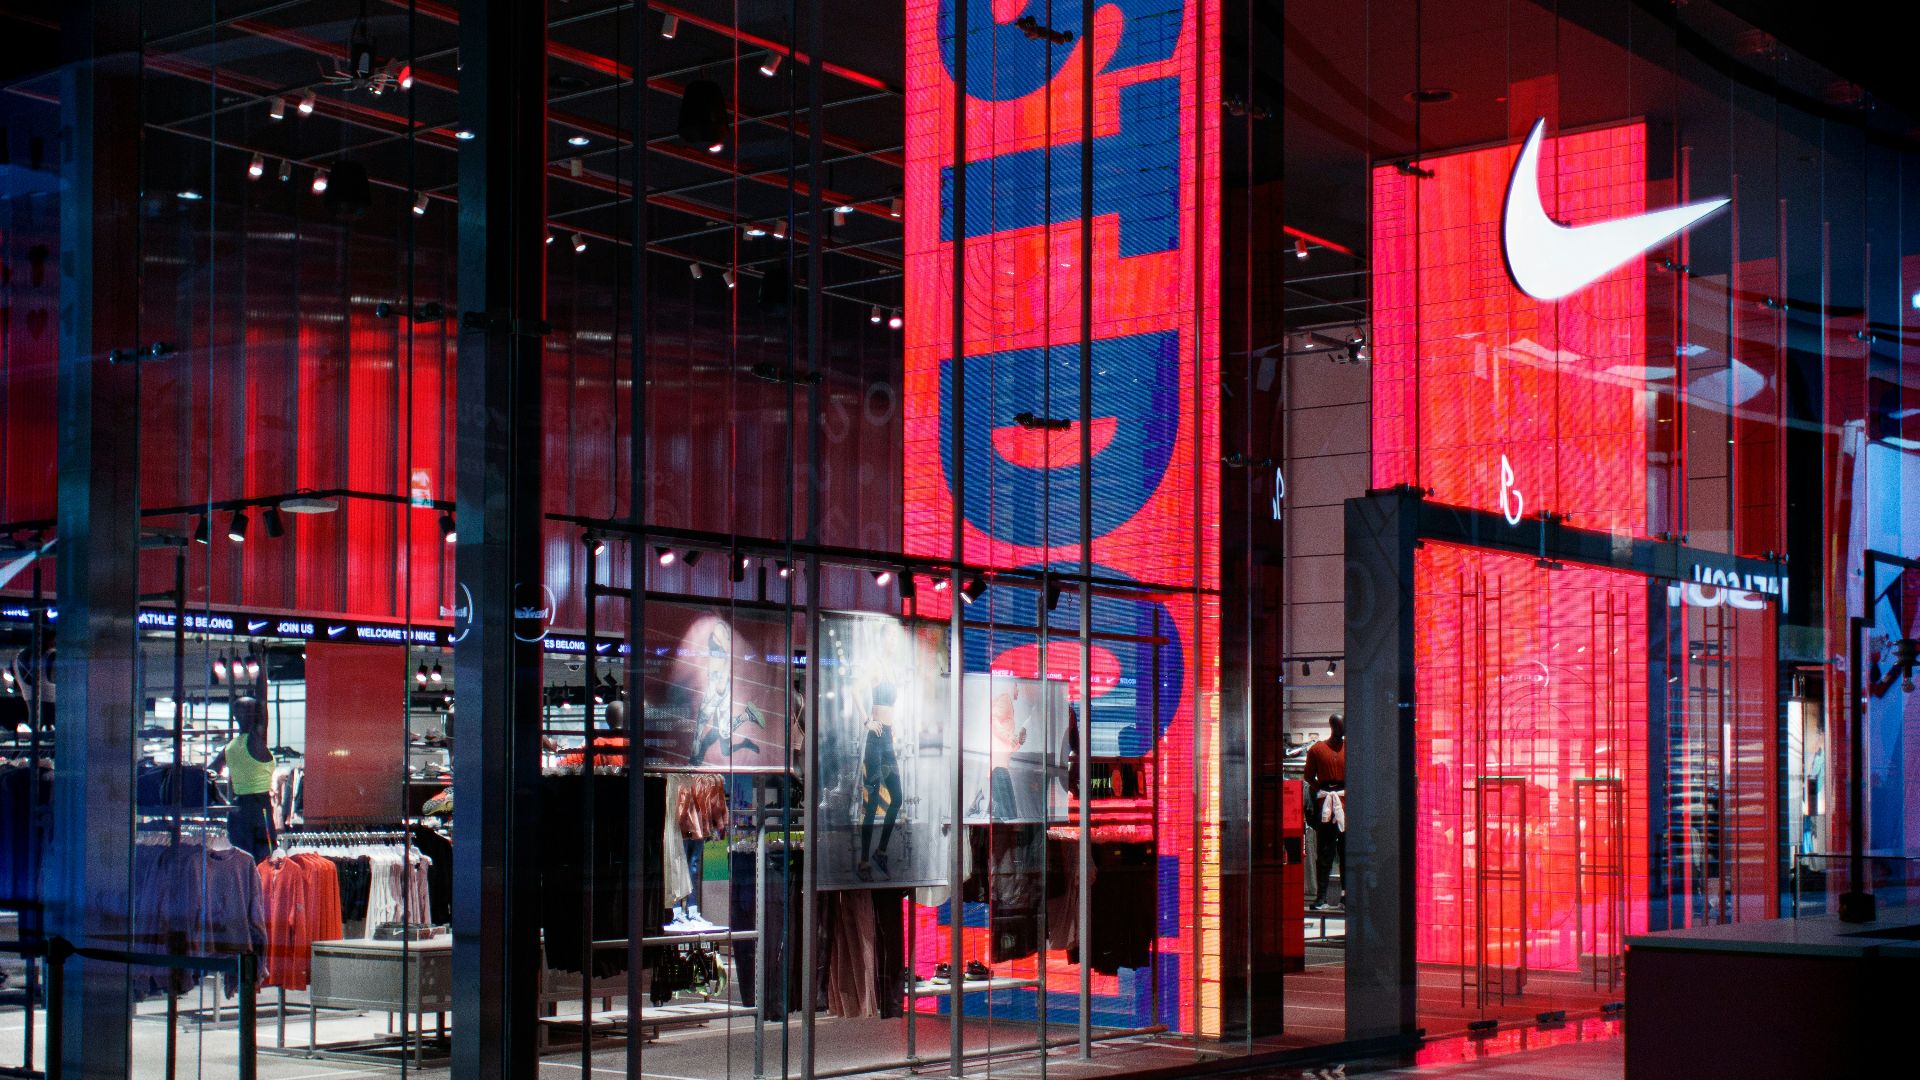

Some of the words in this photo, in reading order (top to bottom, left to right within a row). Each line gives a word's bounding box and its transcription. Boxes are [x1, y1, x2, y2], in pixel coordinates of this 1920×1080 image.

[138, 613, 194, 626] ATHLES
[195, 617, 233, 629] BEONG
[276, 622, 299, 634] JOIN
[300, 623, 315, 635] US
[357, 628, 401, 640] WELCOME
[415, 630, 436, 642] NIKE
[555, 640, 586, 651] BELONG
